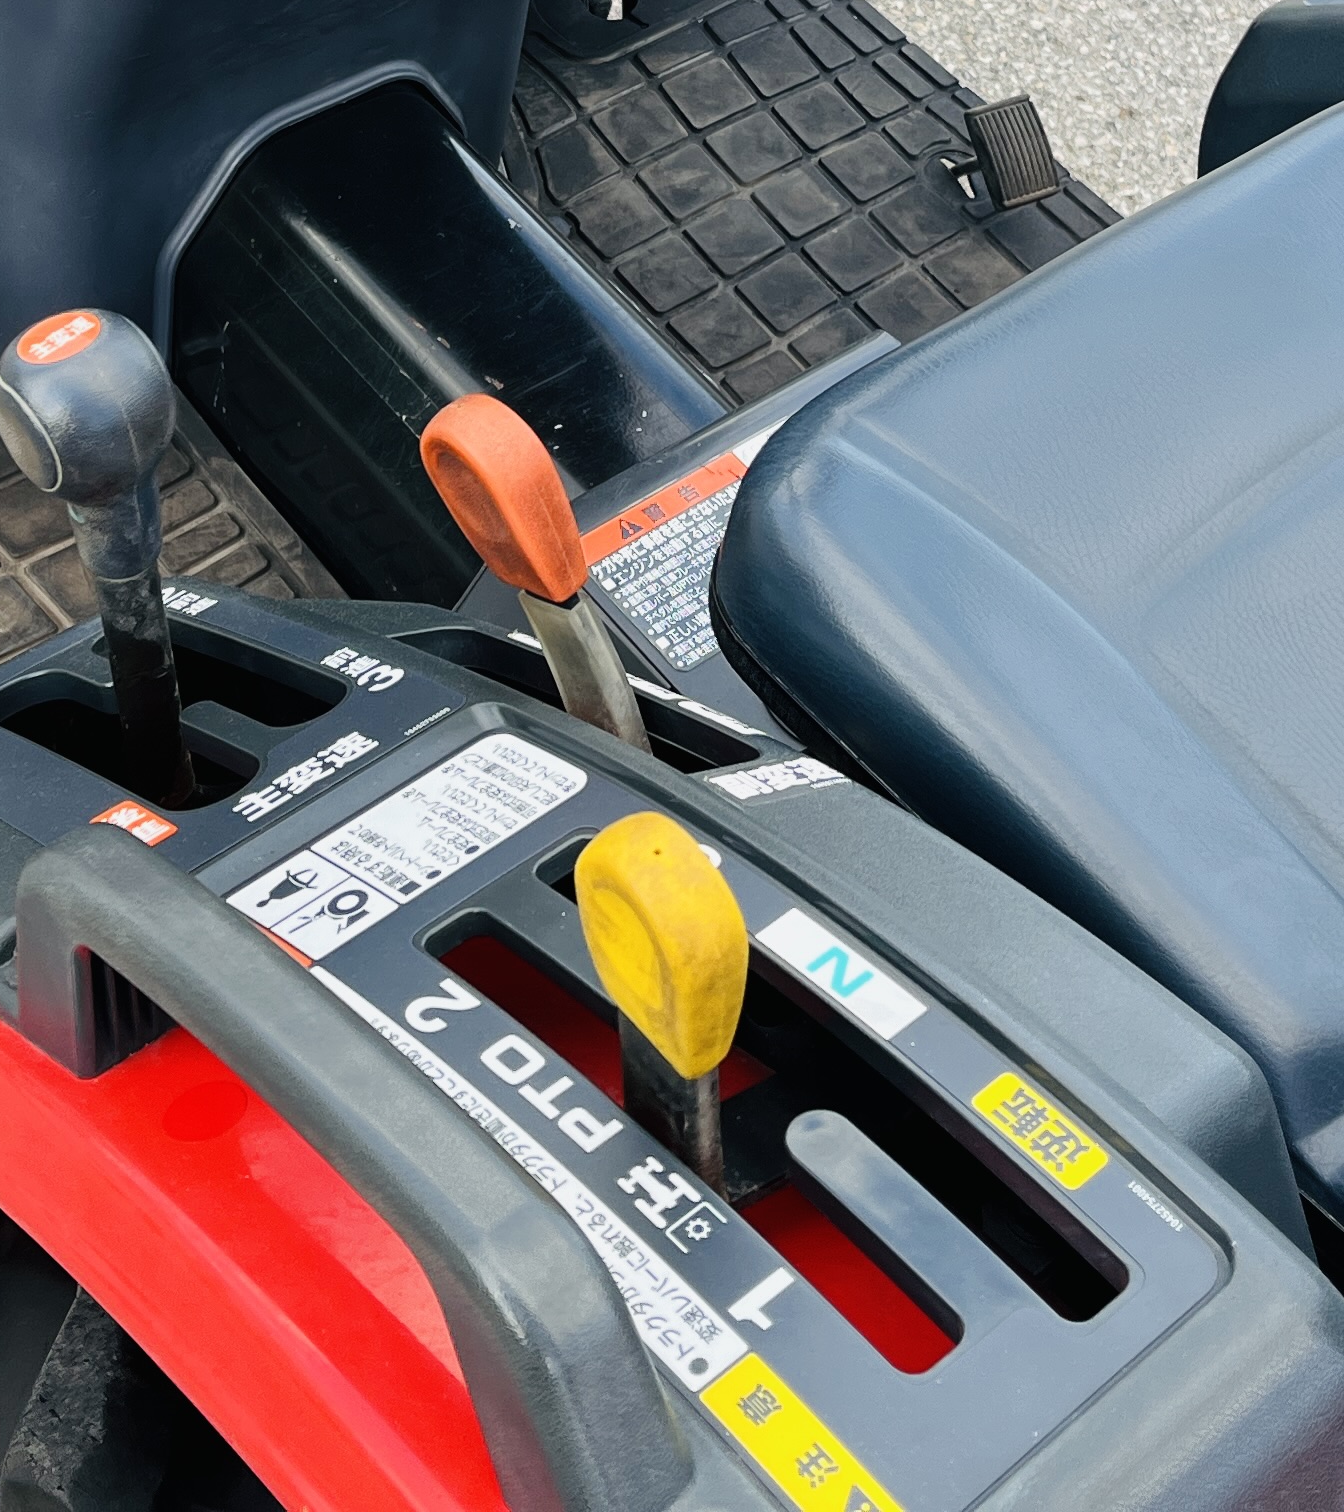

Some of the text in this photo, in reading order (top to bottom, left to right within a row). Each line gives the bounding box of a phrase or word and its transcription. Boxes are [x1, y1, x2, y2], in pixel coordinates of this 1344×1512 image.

[29, 316, 96, 360] 主変速
[232, 731, 379, 822] 主変速
[405, 977, 482, 1033] 2
[806, 946, 874, 998] N
[480, 1034, 624, 1154] PTO
[992, 1087, 1091, 1172] 逆転
[728, 1267, 795, 1330] 1
[737, 1384, 840, 1488] 注意
